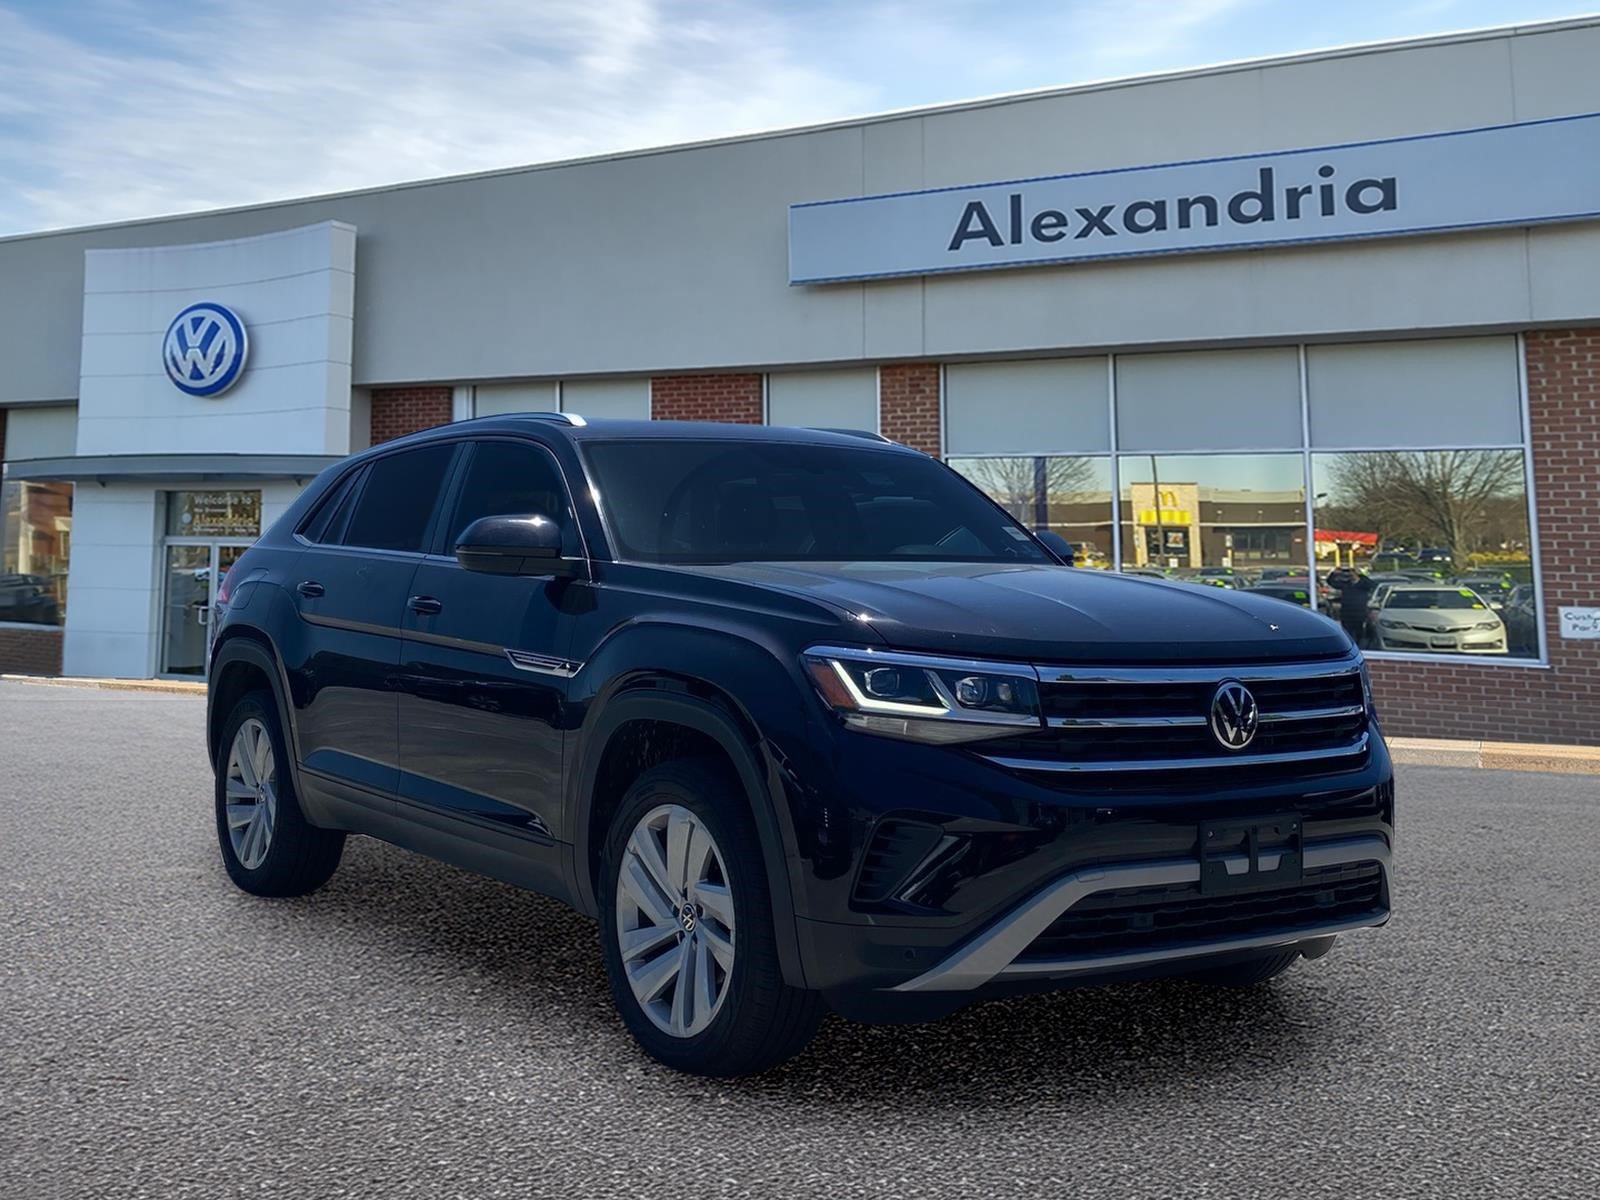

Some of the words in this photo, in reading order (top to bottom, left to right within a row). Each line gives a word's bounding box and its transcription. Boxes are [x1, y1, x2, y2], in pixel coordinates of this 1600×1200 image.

[947, 164, 1398, 251] Alexandria
[164, 304, 242, 393] VW
[1213, 683, 1256, 746] VW
